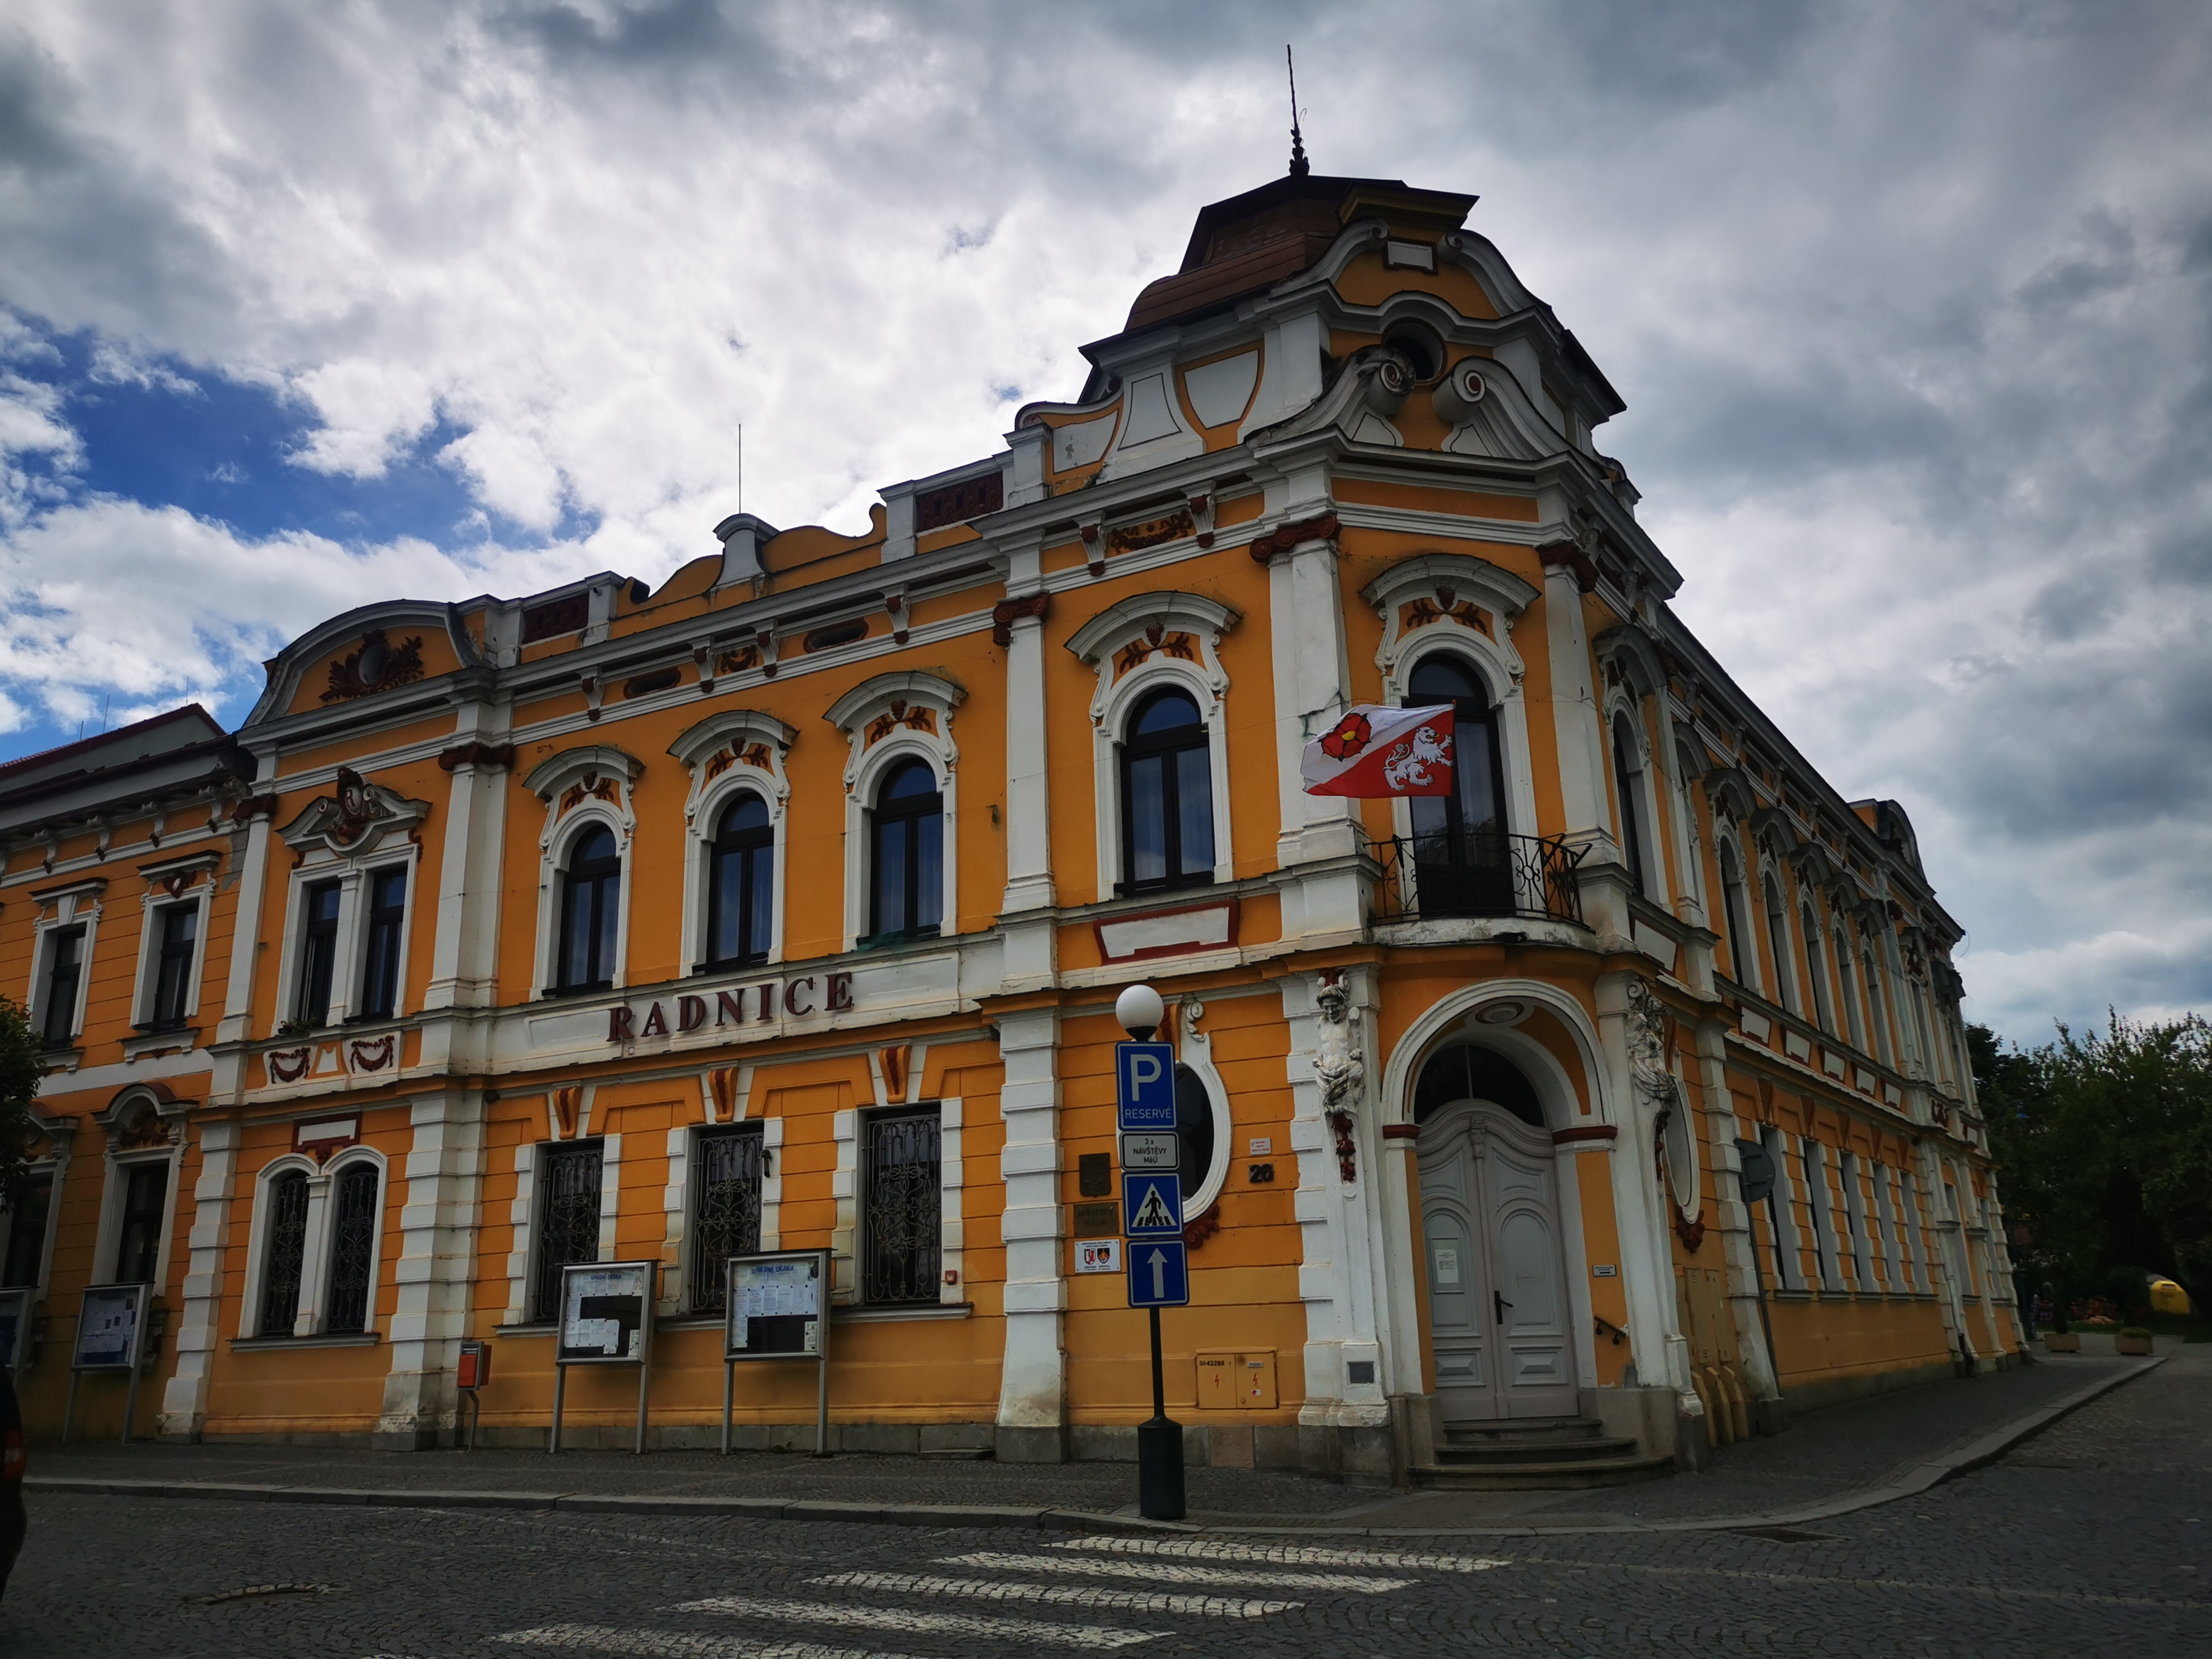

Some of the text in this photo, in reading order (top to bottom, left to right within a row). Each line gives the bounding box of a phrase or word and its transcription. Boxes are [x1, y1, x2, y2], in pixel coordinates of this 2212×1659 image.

[606, 971, 854, 1042] RADNICE
[1130, 1054, 1162, 1101] P
[1125, 1106, 1172, 1119] RÉSERVÉ
[1133, 1146, 1167, 1155] NÁVŠTĚVY
[1144, 1155, 1158, 1164] MěÚ
[1249, 1164, 1273, 1182] 26
